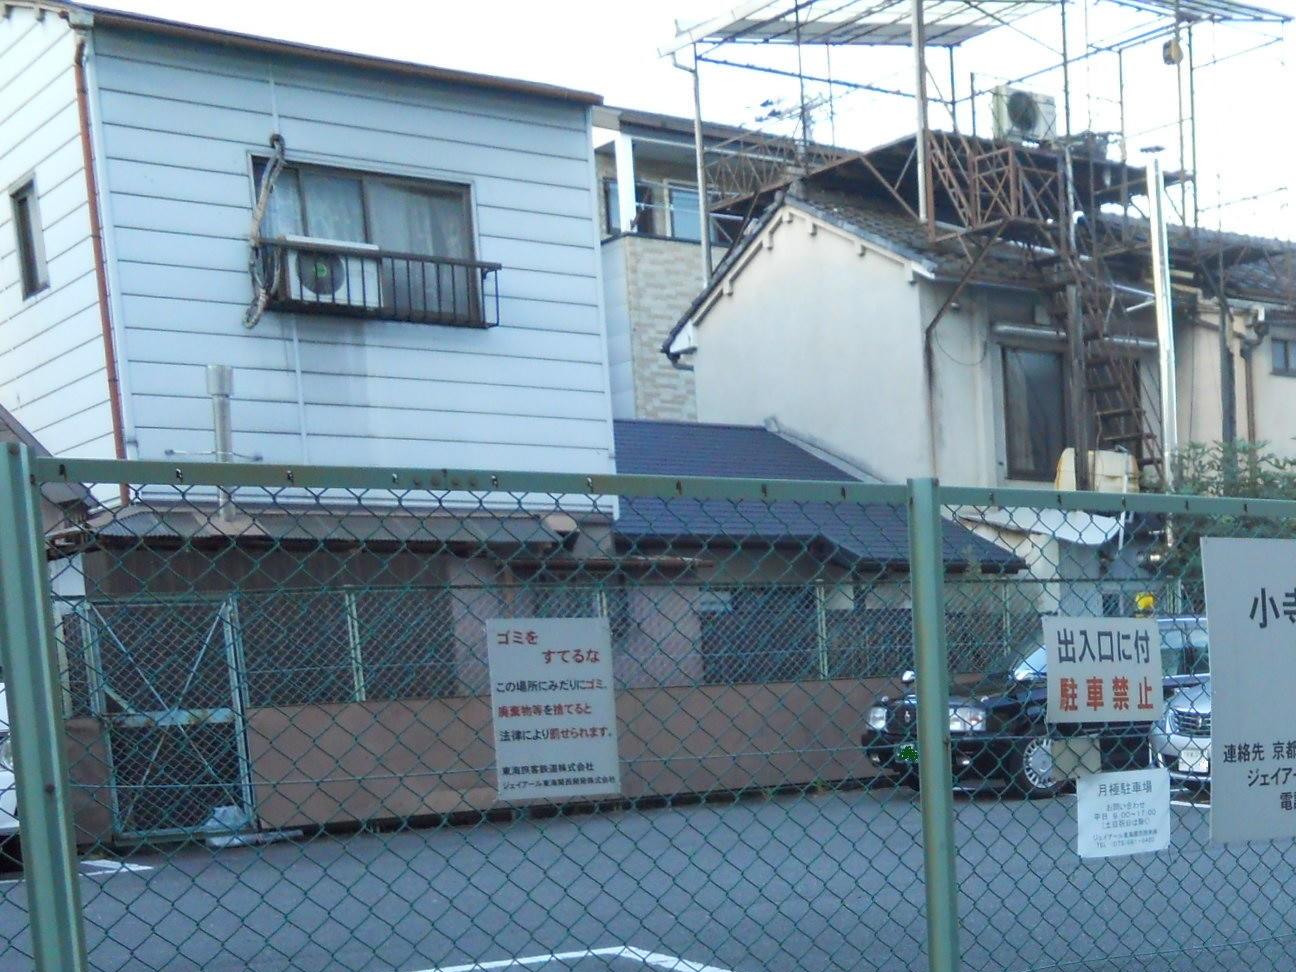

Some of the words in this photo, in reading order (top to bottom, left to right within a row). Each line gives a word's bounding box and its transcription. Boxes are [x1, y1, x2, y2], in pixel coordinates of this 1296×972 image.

[497, 630, 539, 646] ゴミを
[1057, 627, 1150, 664] 出入口に付
[542, 648, 601, 664] すてるな
[1059, 676, 1154, 712] 駐車禁止
[498, 703, 592, 719] 廃棄物等を捨てると
[1223, 742, 1265, 764] 連絡先
[1098, 780, 1153, 797] 月極駐車場
